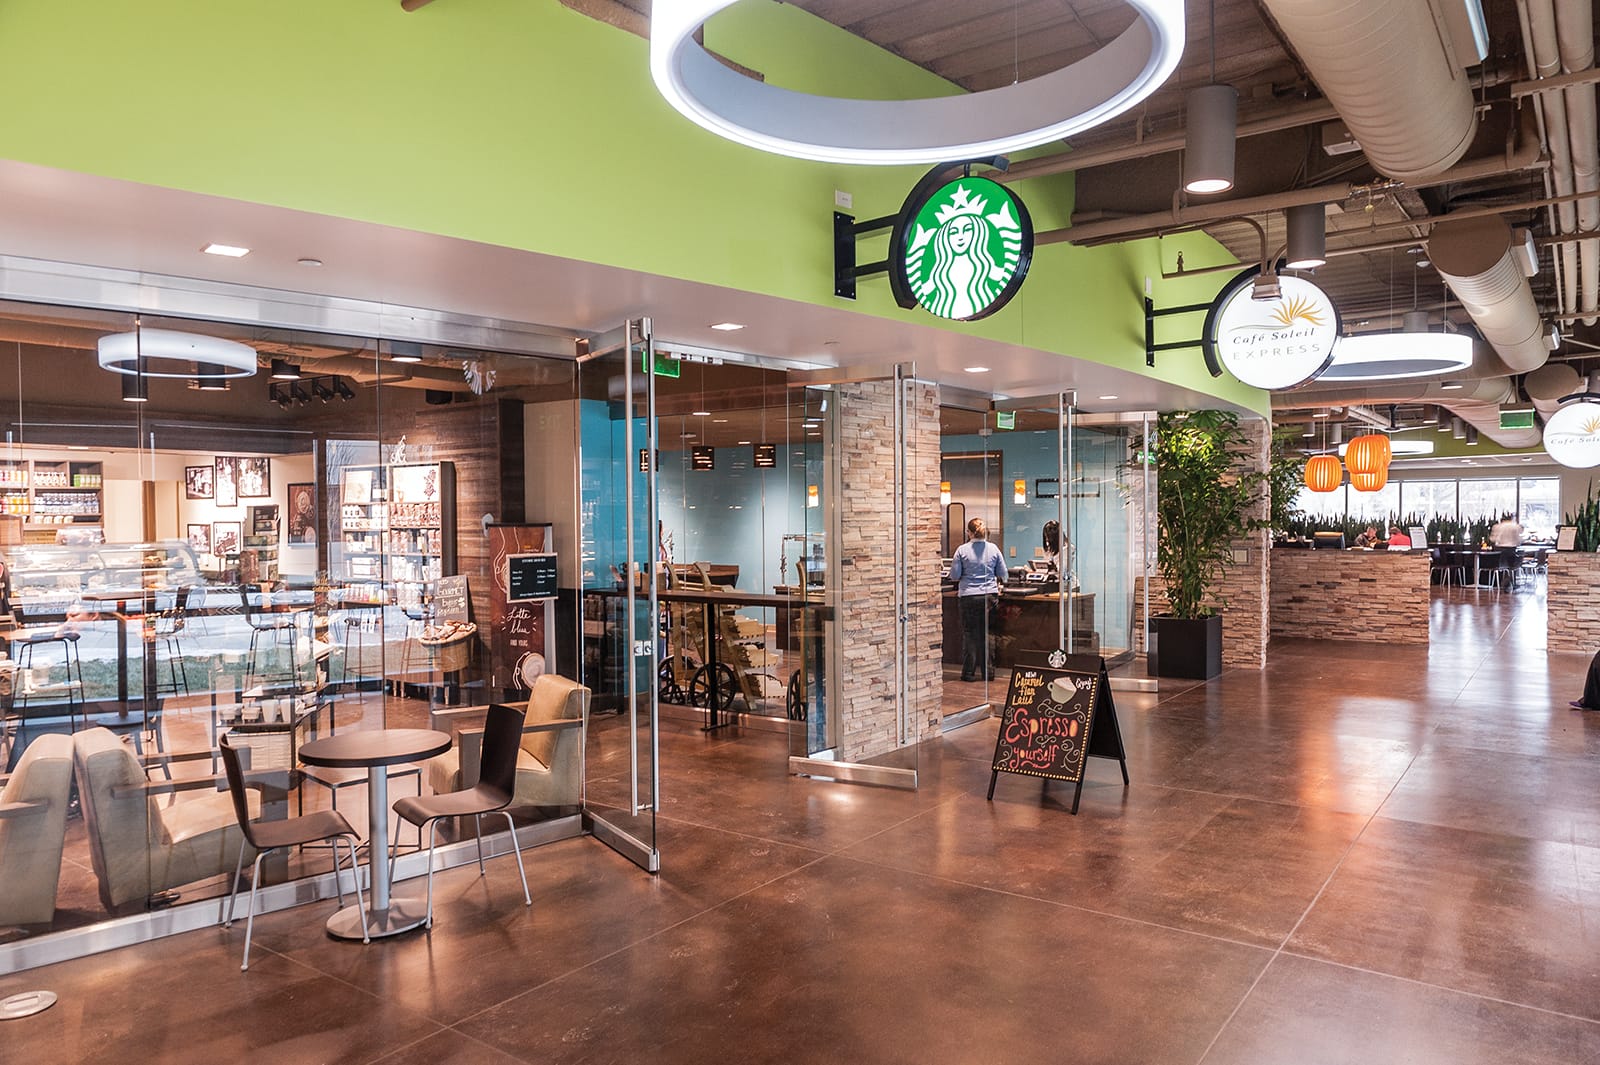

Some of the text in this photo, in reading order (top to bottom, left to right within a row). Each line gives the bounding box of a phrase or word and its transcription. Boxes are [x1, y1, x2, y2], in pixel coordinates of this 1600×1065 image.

[1233, 328, 1315, 345] Café Soleil
[1233, 344, 1320, 360] EXPRESS
[507, 606, 531, 622] Latte
[1014, 672, 1045, 688] Caramel
[1005, 707, 1079, 748] Espresso
[1009, 744, 1060, 769] yourself
